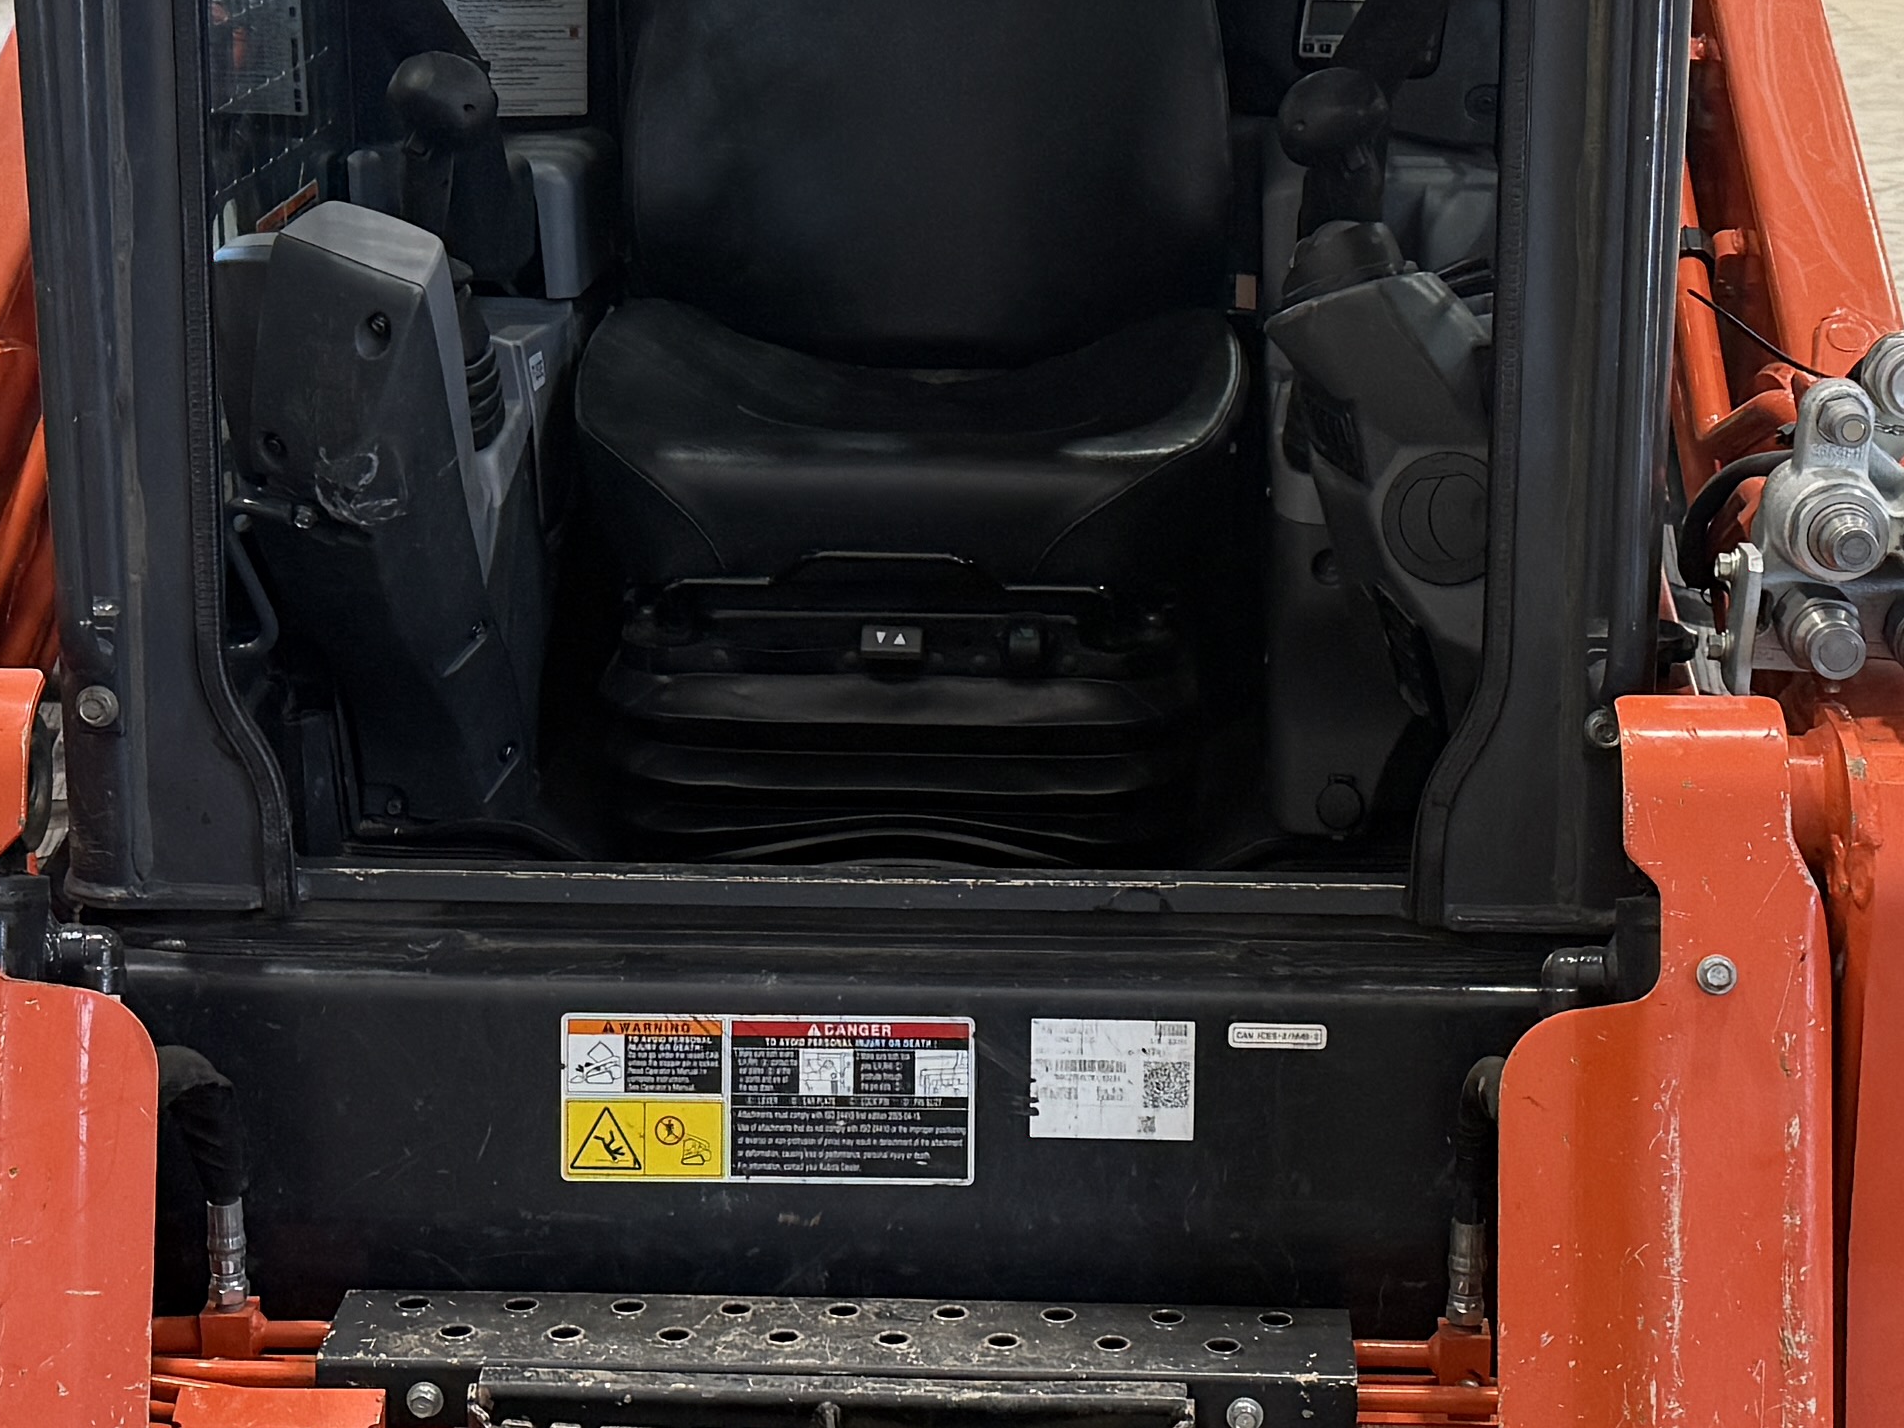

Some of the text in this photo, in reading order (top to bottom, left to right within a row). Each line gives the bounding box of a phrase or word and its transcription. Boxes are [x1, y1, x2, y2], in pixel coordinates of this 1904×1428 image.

[825, 1024, 892, 1036] DANGER
[765, 1038, 776, 1046] TO
[778, 1038, 805, 1046] AVOID
[807, 1038, 852, 1047] PERSONAL
[855, 1039, 885, 1047] INJURY
[888, 1039, 901, 1047] OR
